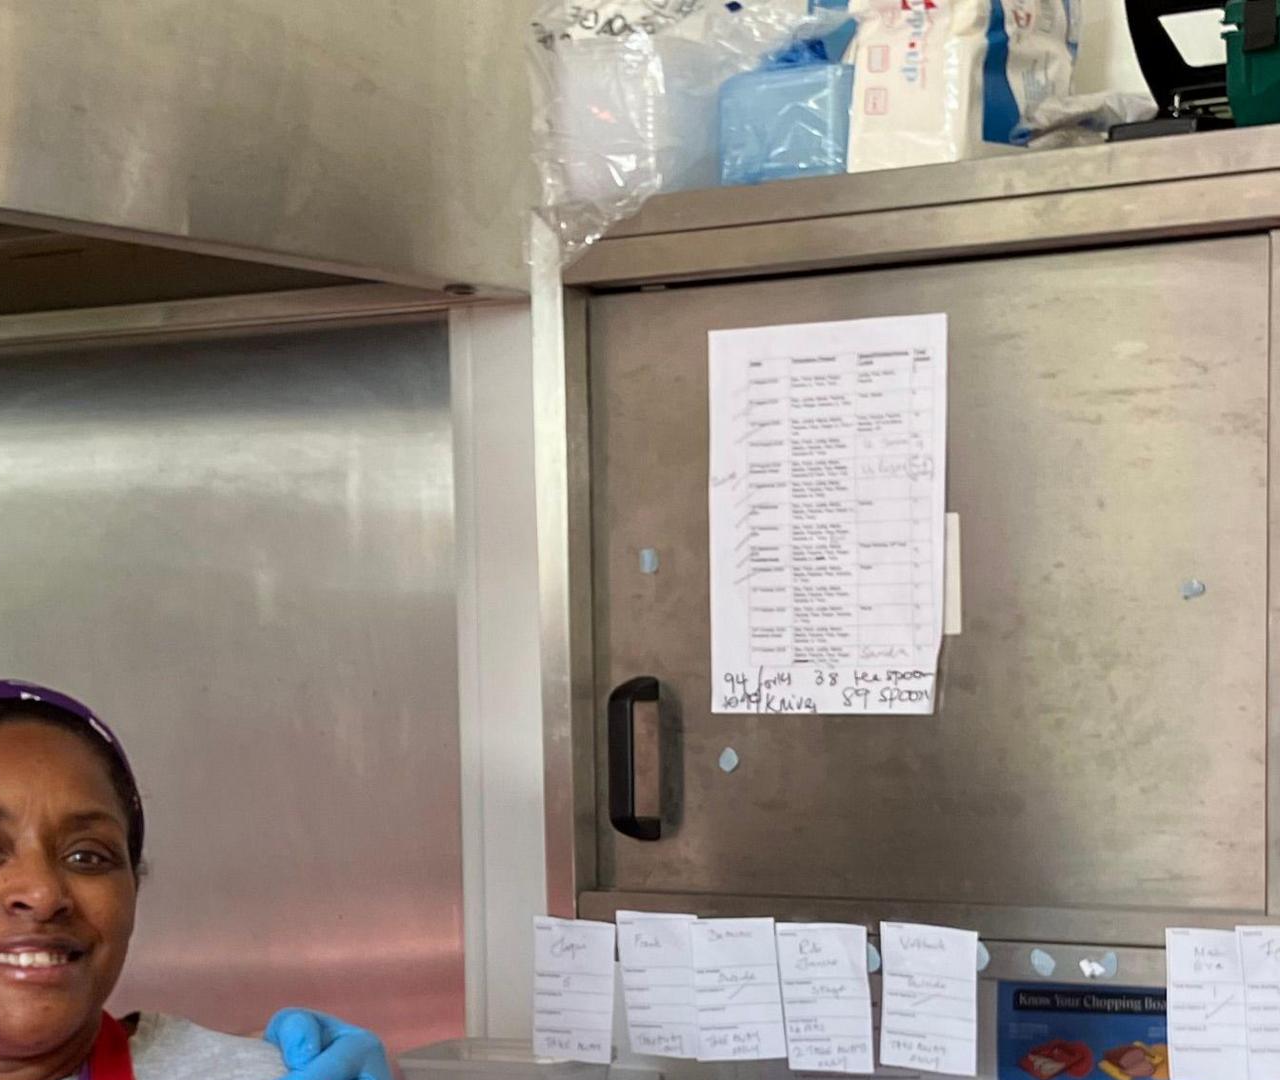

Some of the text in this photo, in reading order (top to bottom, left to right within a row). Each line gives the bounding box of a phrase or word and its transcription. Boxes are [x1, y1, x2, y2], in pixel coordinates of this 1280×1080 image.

[815, 669, 839, 687] 38
[1017, 991, 1051, 1007] Know
[1053, 992, 1081, 1009] Your
[1082, 994, 1142, 1012] Chopping
